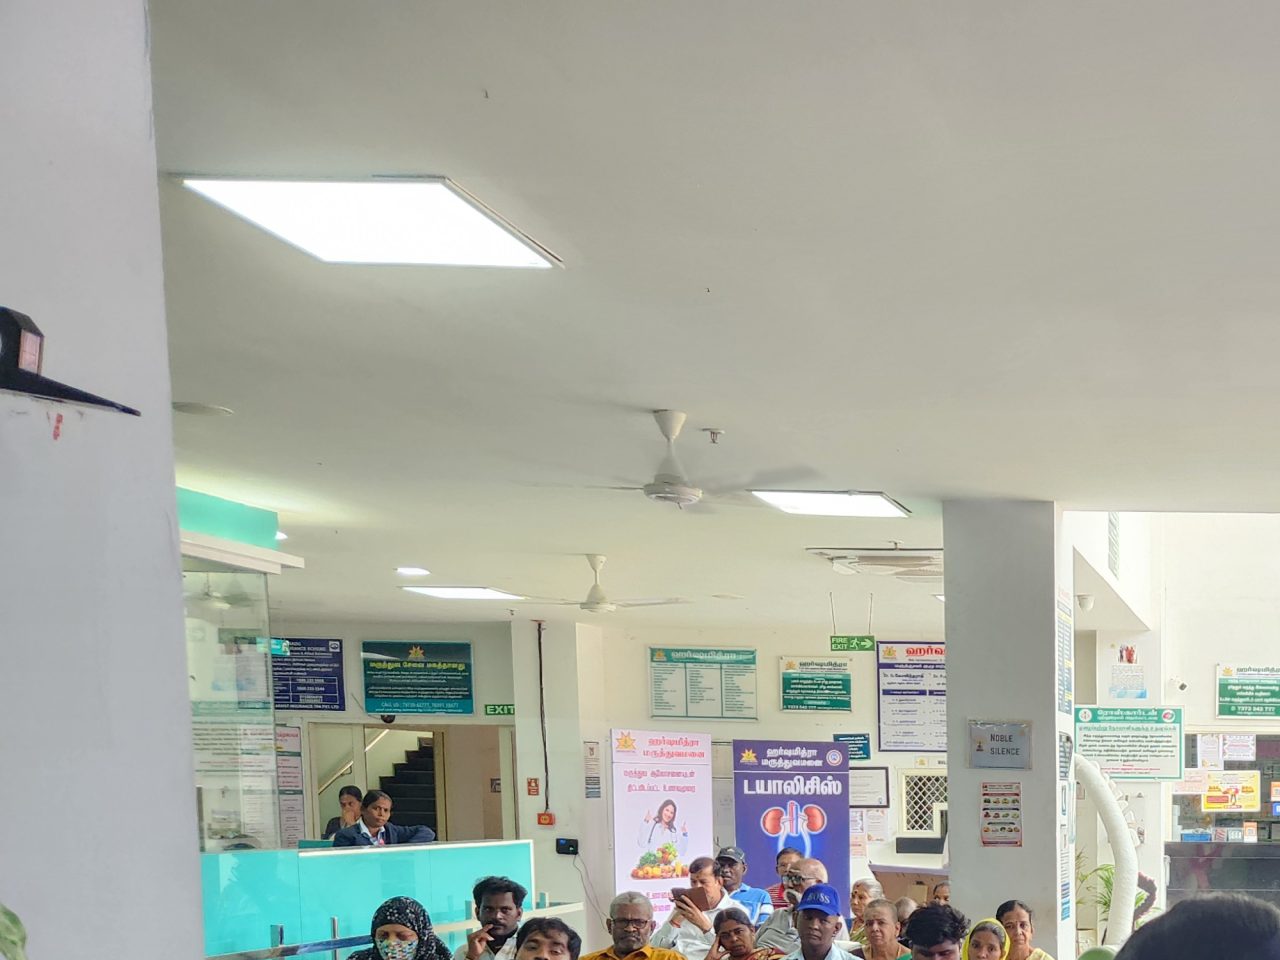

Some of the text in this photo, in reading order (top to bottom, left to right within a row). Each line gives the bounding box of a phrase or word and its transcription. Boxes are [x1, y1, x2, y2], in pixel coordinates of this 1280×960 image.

[486, 705, 515, 714] EXIT
[990, 733, 1013, 743] NOBLE
[643, 748, 705, 759] மருத்துவமனை
[766, 746, 818, 758] ஹர்ஷமித்ரா
[990, 747, 1020, 756] SILENCE
[761, 757, 823, 769] மருத்துவமனை
[743, 775, 843, 795] டயாலிசிஸ்
